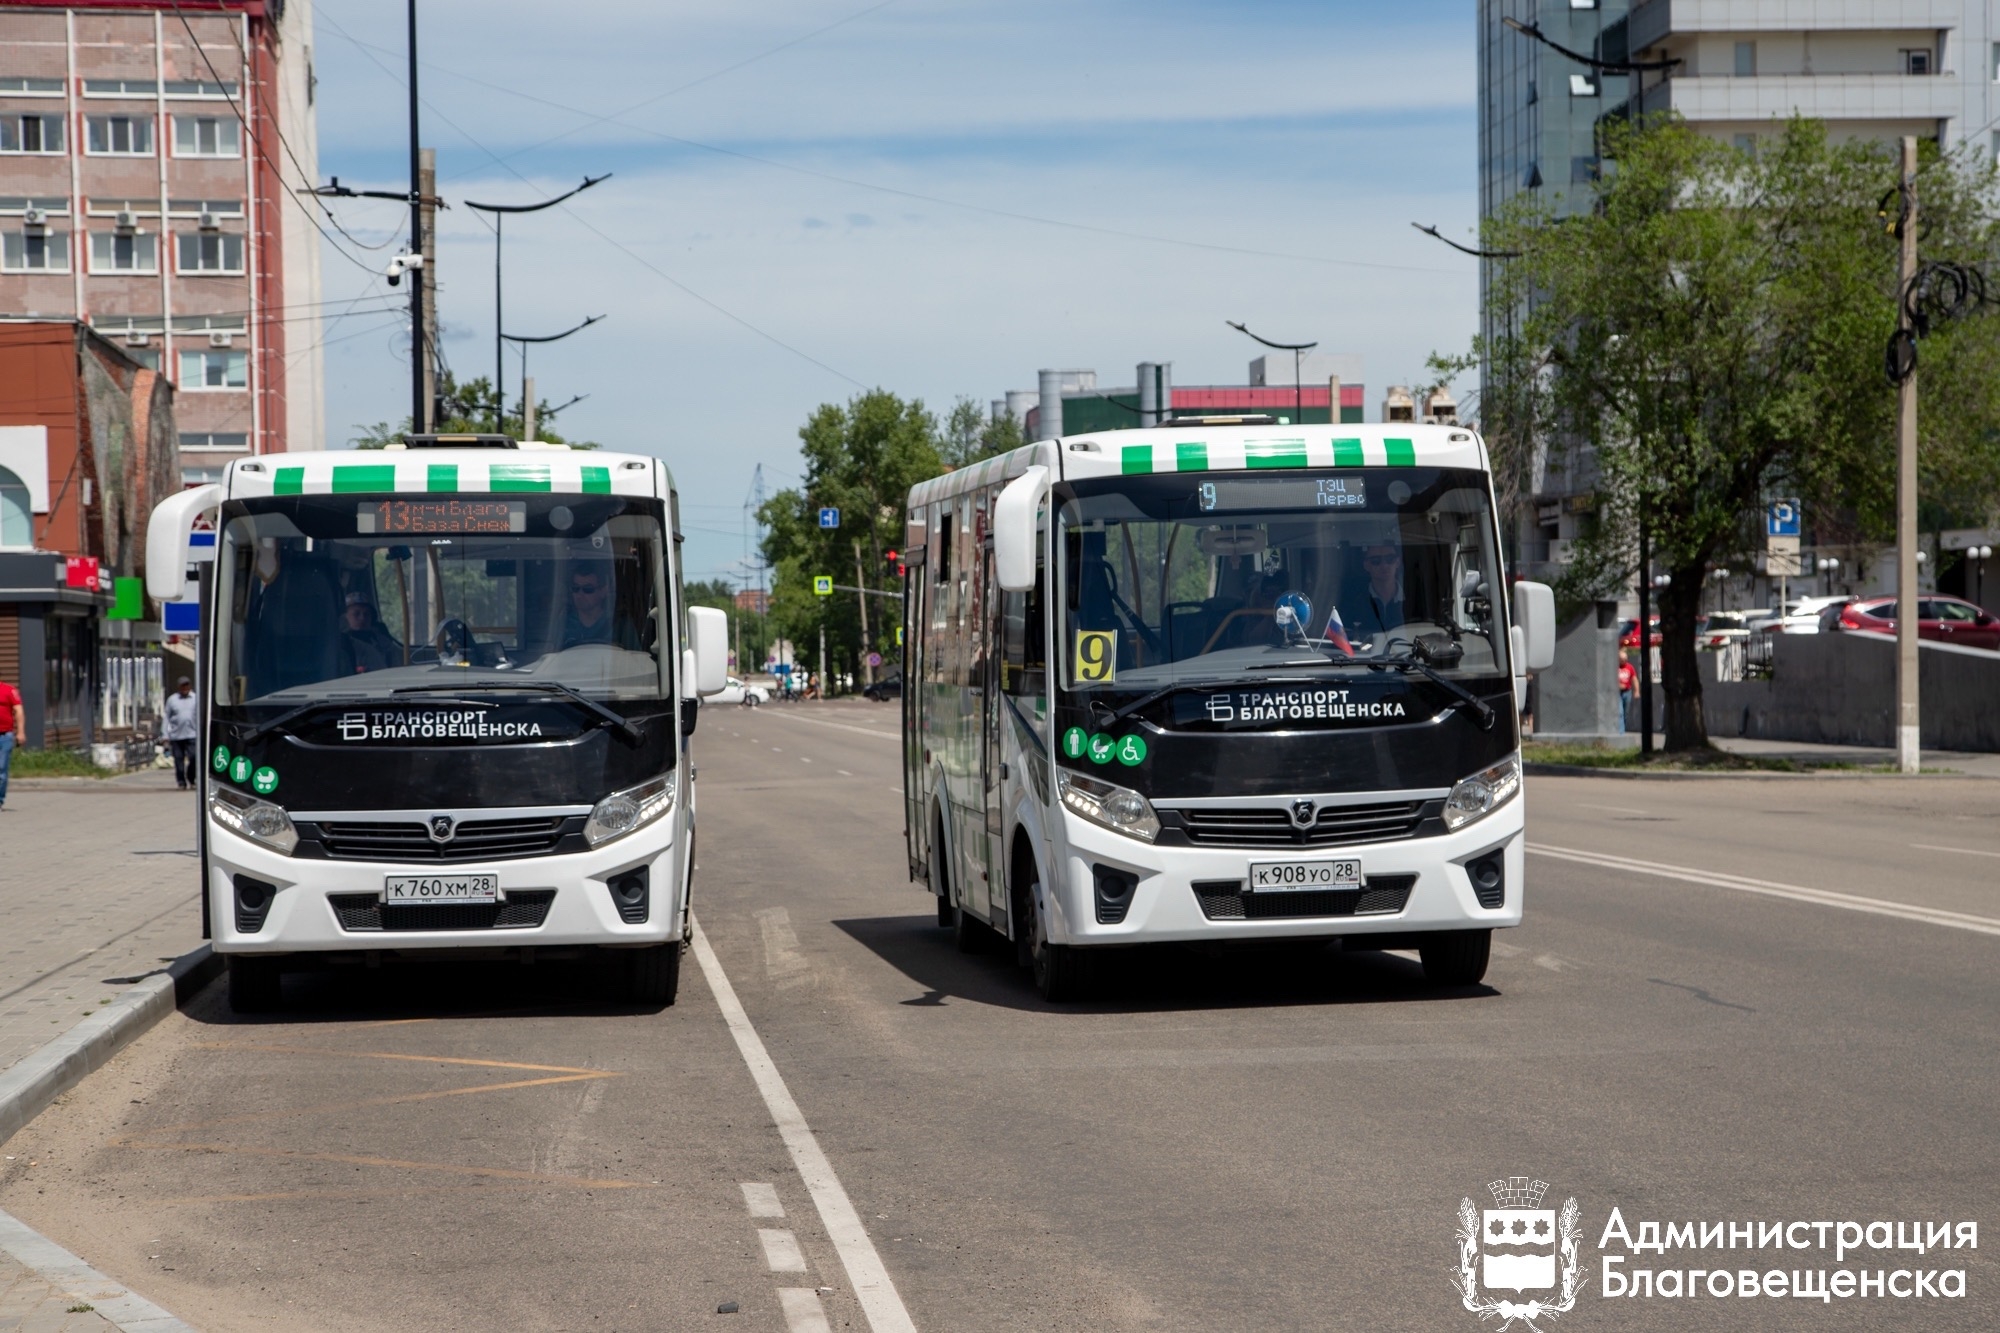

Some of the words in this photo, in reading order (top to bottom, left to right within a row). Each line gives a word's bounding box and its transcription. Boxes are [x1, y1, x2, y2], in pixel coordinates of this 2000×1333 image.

[1316, 479, 1346, 493] ТЭЦ
[1202, 483, 1217, 510] 9
[379, 500, 410, 531] 13
[450, 500, 508, 515] Благо
[412, 516, 460, 532] База
[1774, 503, 1793, 533] P
[1080, 634, 1113, 681] 9
[1239, 690, 1349, 706] ТРАНСПОРТ
[371, 710, 487, 725] ТРАНСПОРТ
[1240, 702, 1406, 721] БЛАГОВЕЩЕНСКА
[371, 723, 542, 739] БЛАГОВЕЩЕНСКА
[1335, 863, 1353, 877] 28
[472, 878, 490, 891] 28
